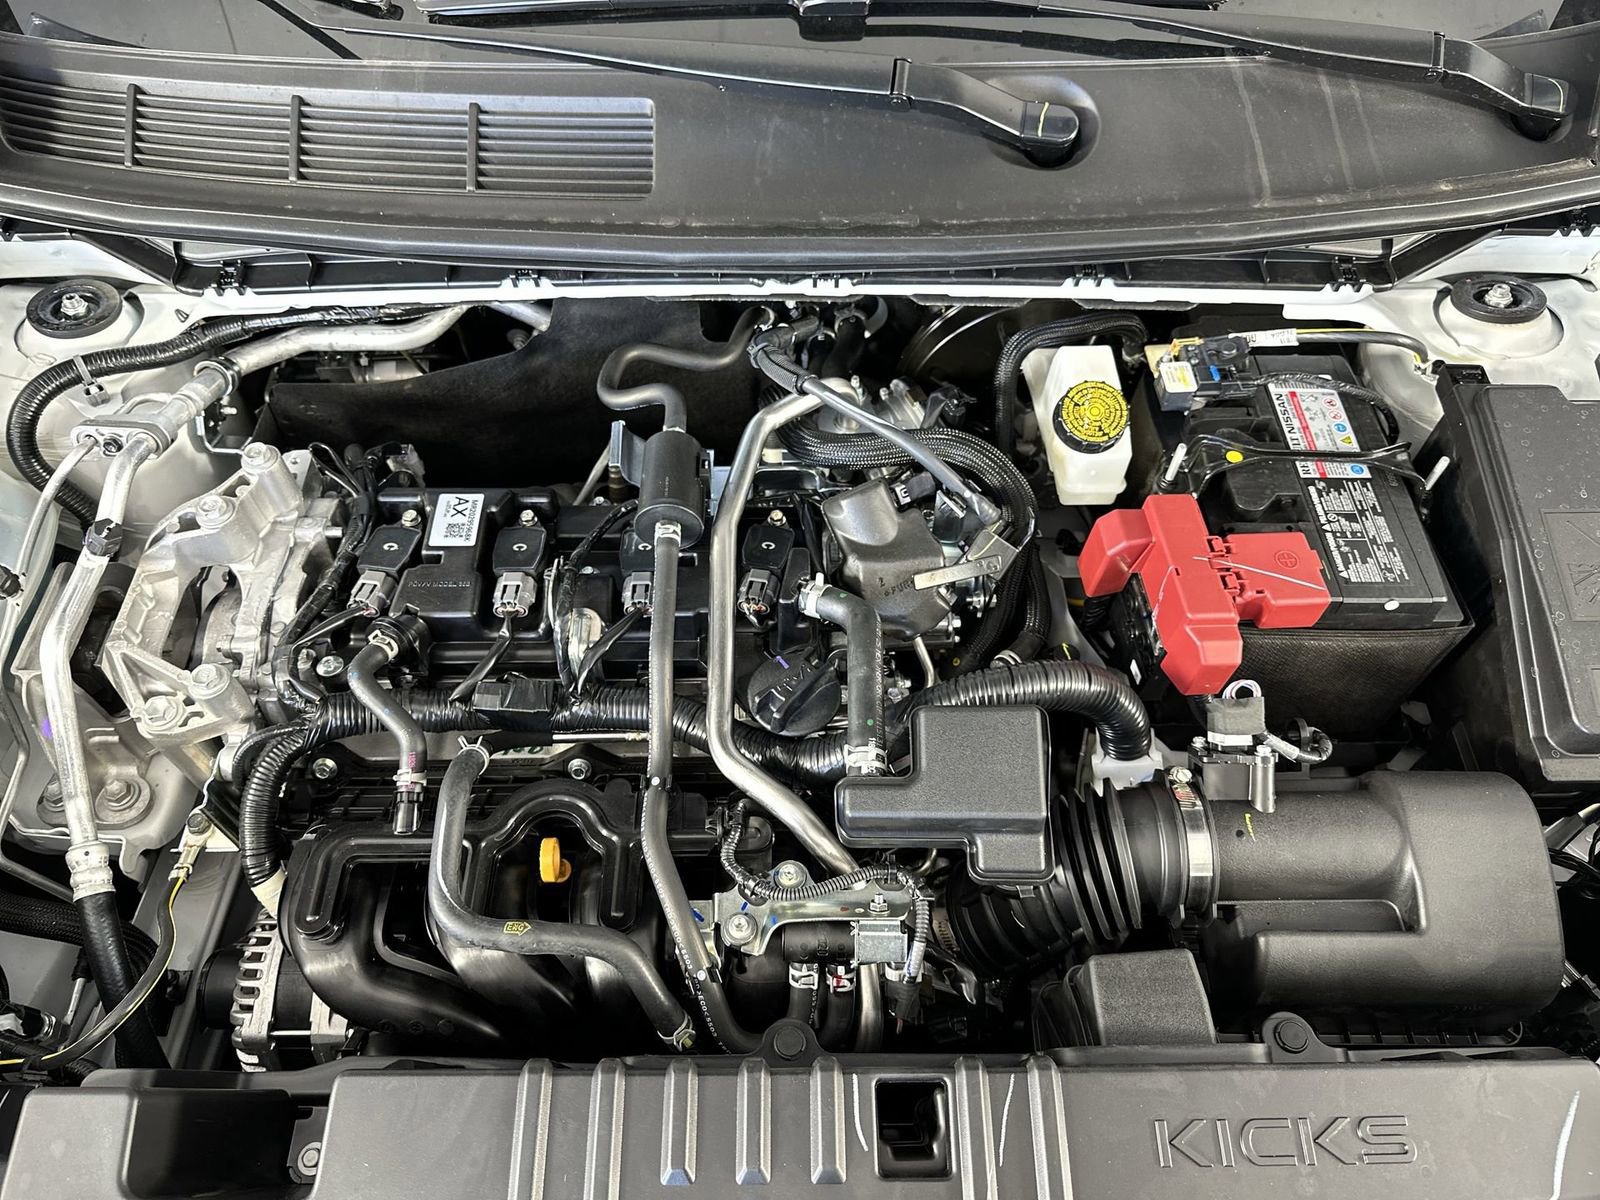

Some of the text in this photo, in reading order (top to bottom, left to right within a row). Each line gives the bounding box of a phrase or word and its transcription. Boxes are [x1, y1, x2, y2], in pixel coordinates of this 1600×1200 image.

[1274, 393, 1297, 435] NISSAN
[1290, 436, 1312, 476] RELT
[451, 496, 469, 518] AX
[506, 922, 525, 931] ENG
[1153, 1115, 1418, 1168] KICKS
